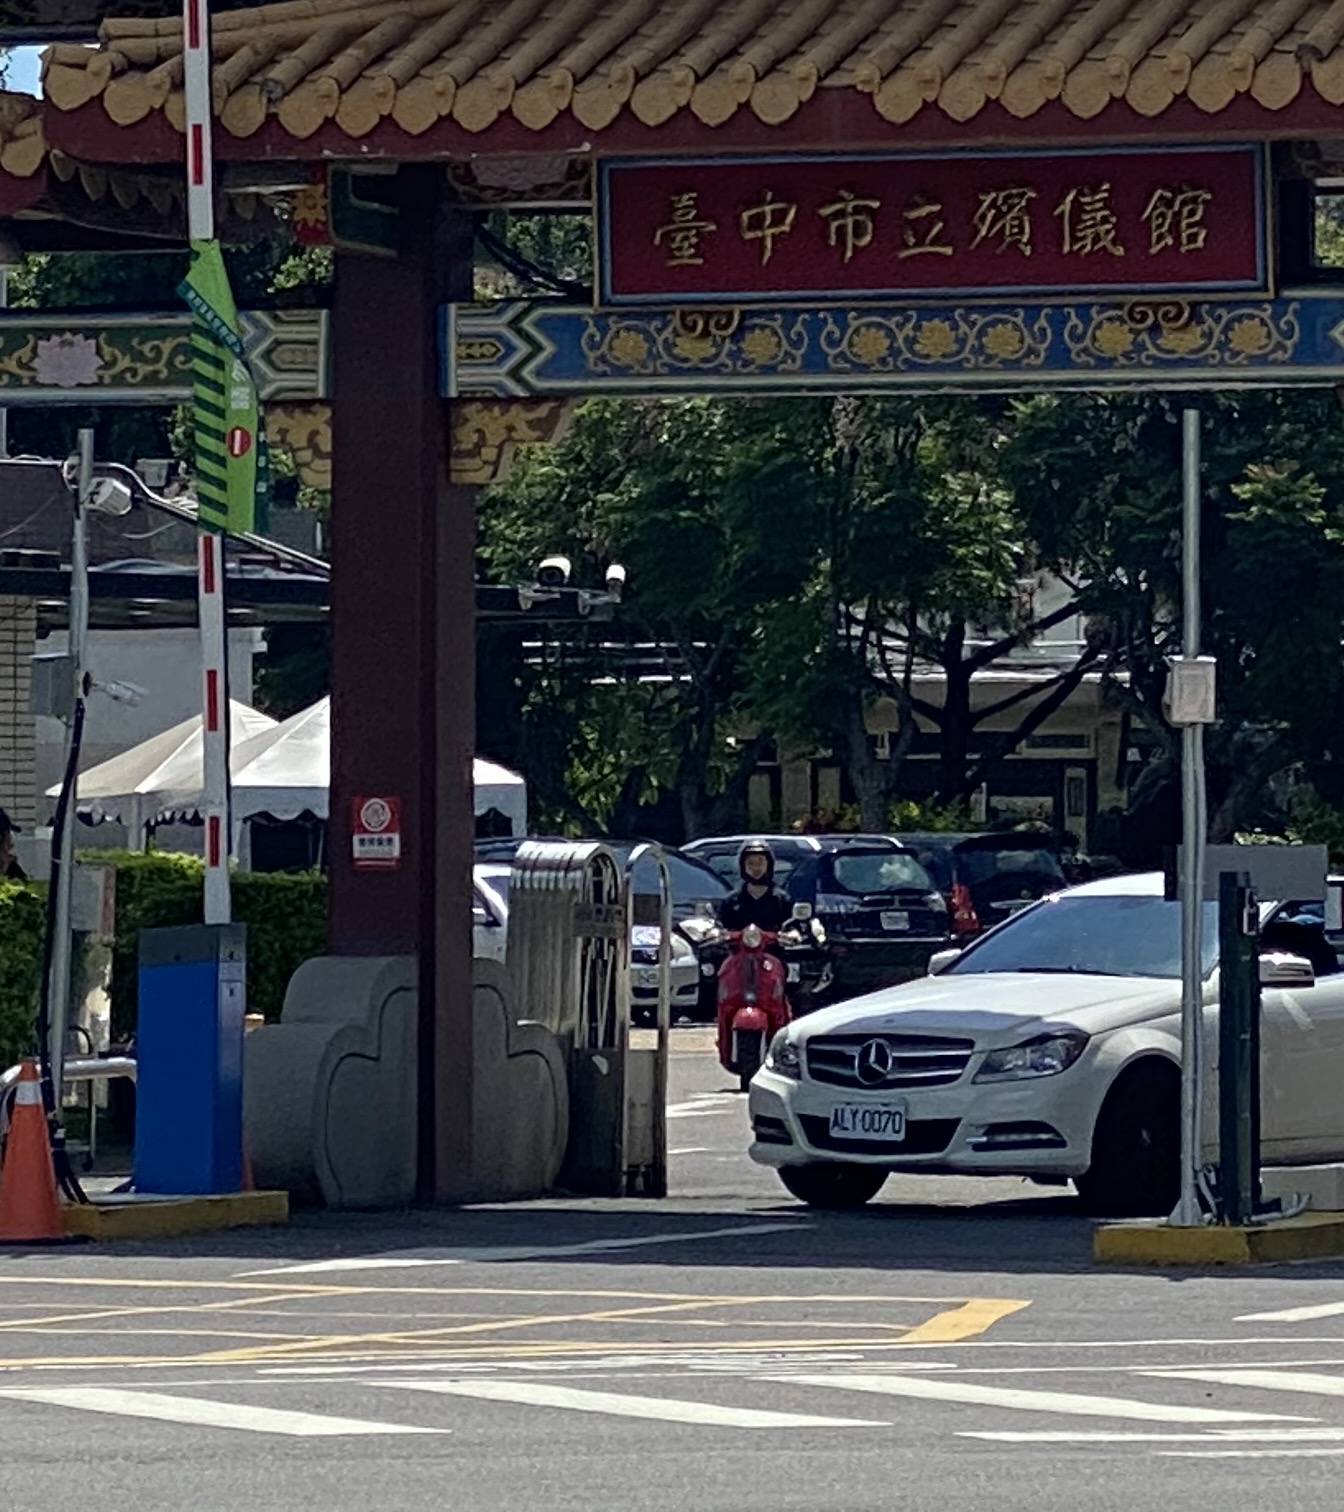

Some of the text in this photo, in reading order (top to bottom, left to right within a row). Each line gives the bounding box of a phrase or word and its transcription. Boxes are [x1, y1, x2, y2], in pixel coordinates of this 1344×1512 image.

[654, 182, 1212, 267] 臺中市立殯儀館
